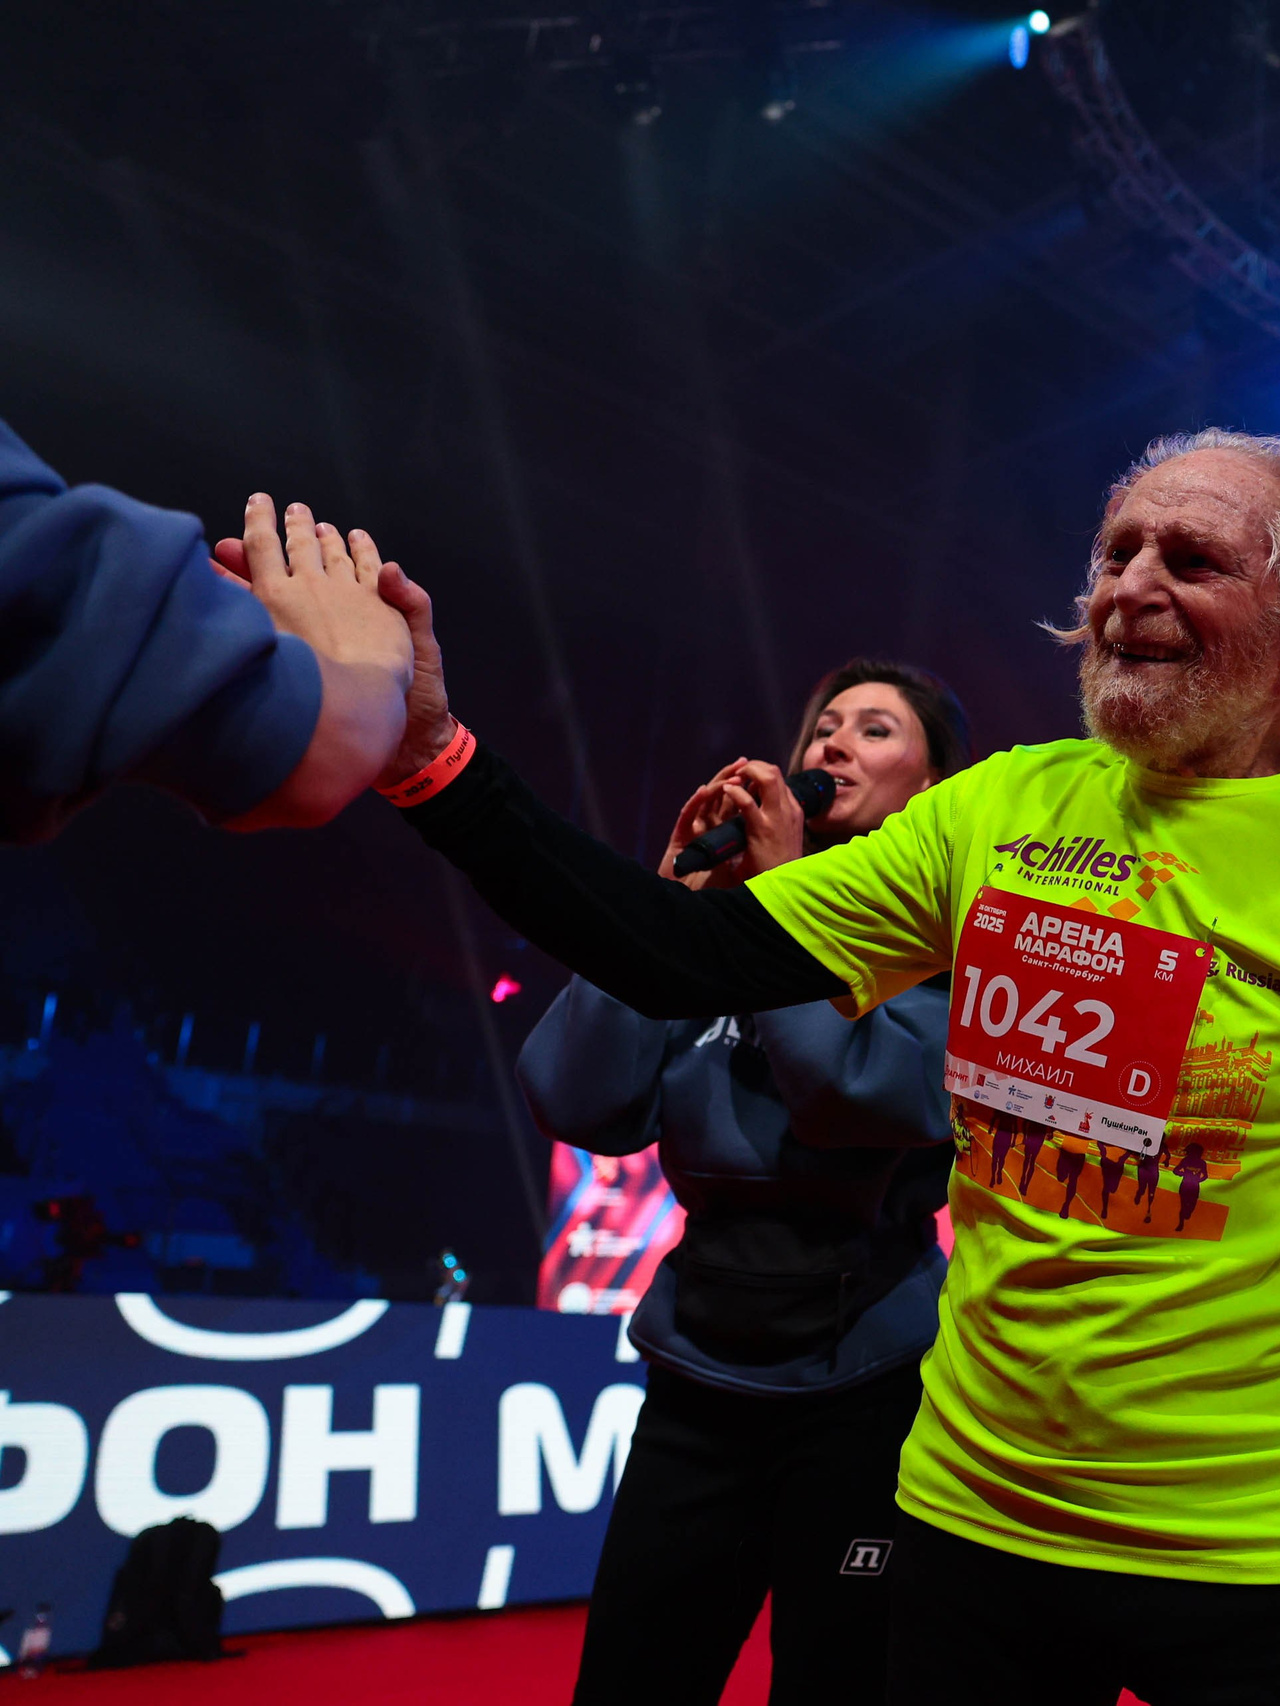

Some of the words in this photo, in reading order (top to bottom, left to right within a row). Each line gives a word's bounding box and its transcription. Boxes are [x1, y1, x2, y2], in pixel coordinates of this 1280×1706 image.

[403, 776, 434, 798] 2025
[993, 833, 1138, 882] Achilles
[1017, 866, 1120, 897] INTERNATIONAL
[973, 912, 1005, 934] 2025
[1019, 911, 1125, 958] АРЕНА
[1013, 933, 1126, 977] МАРАФОН
[1021, 954, 1106, 983] Санкт-Петербург
[1157, 949, 1179, 972] 5
[959, 964, 1116, 1069] 1042
[995, 1050, 1075, 1088] МИХАИЛ
[1127, 1068, 1152, 1098] D
[1101, 1116, 1148, 1137] ПушкинРан
